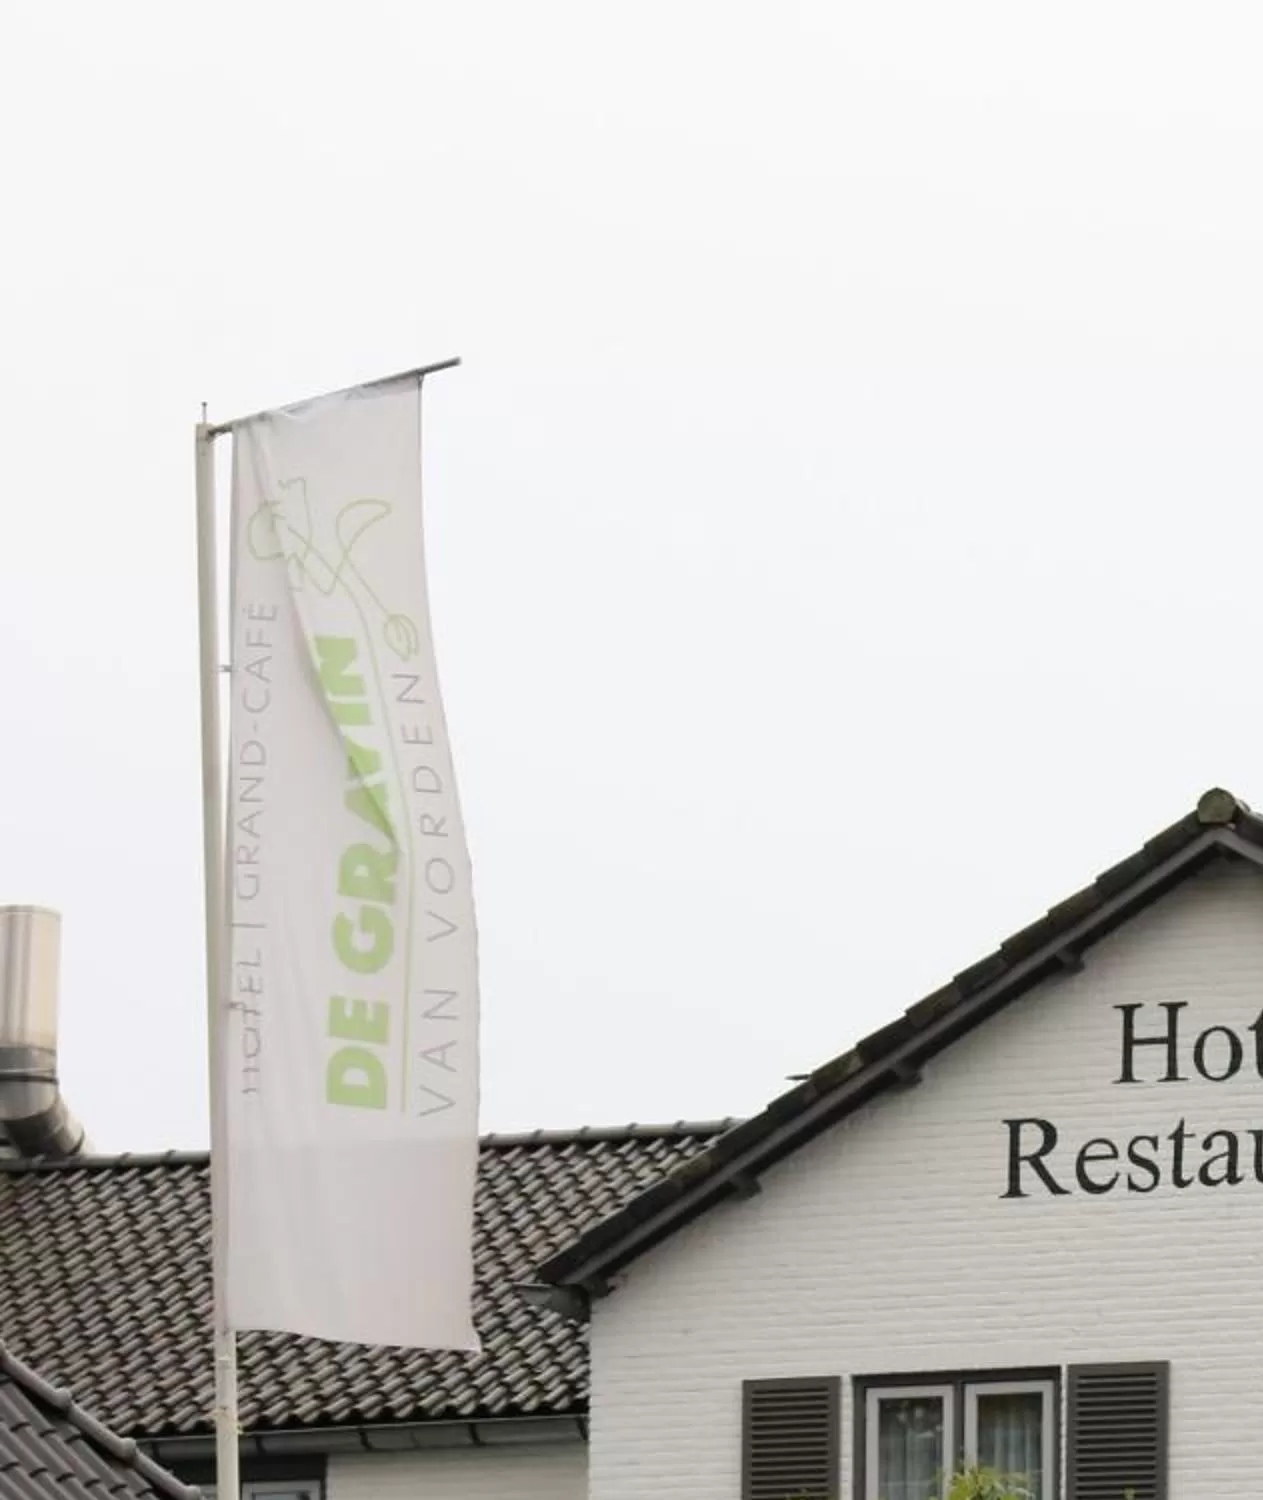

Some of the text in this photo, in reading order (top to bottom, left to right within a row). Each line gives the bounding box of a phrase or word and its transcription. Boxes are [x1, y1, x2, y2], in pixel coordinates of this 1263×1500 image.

[236, 947, 263, 1095] HOTEL
[313, 634, 401, 1110] DE GRAVIN
[391, 672, 459, 1117] VAN VORDEN
